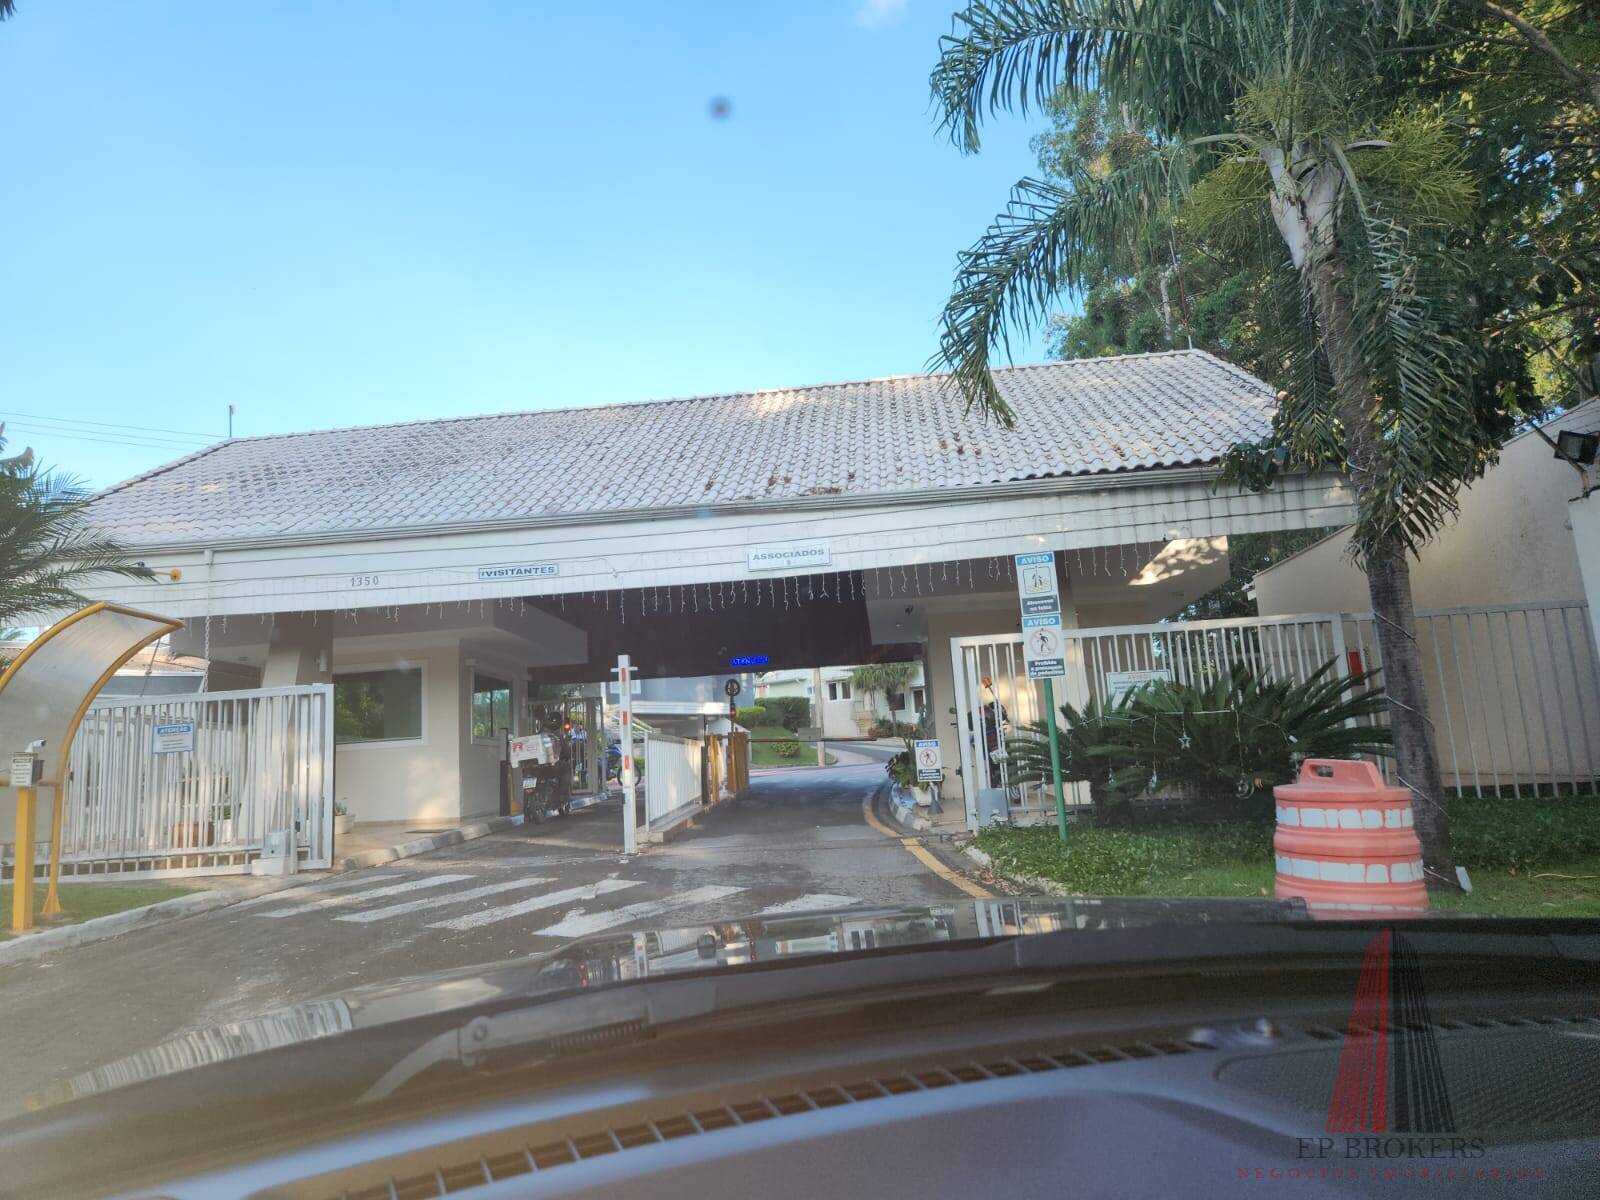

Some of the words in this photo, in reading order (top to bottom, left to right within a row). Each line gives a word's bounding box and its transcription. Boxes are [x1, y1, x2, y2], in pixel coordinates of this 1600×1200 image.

[752, 548, 824, 561] ASSOCIADOS
[1020, 554, 1050, 565] AVISO
[485, 565, 555, 577] VISITANTES
[350, 575, 379, 588] 1350
[1027, 617, 1056, 626] AVISO
